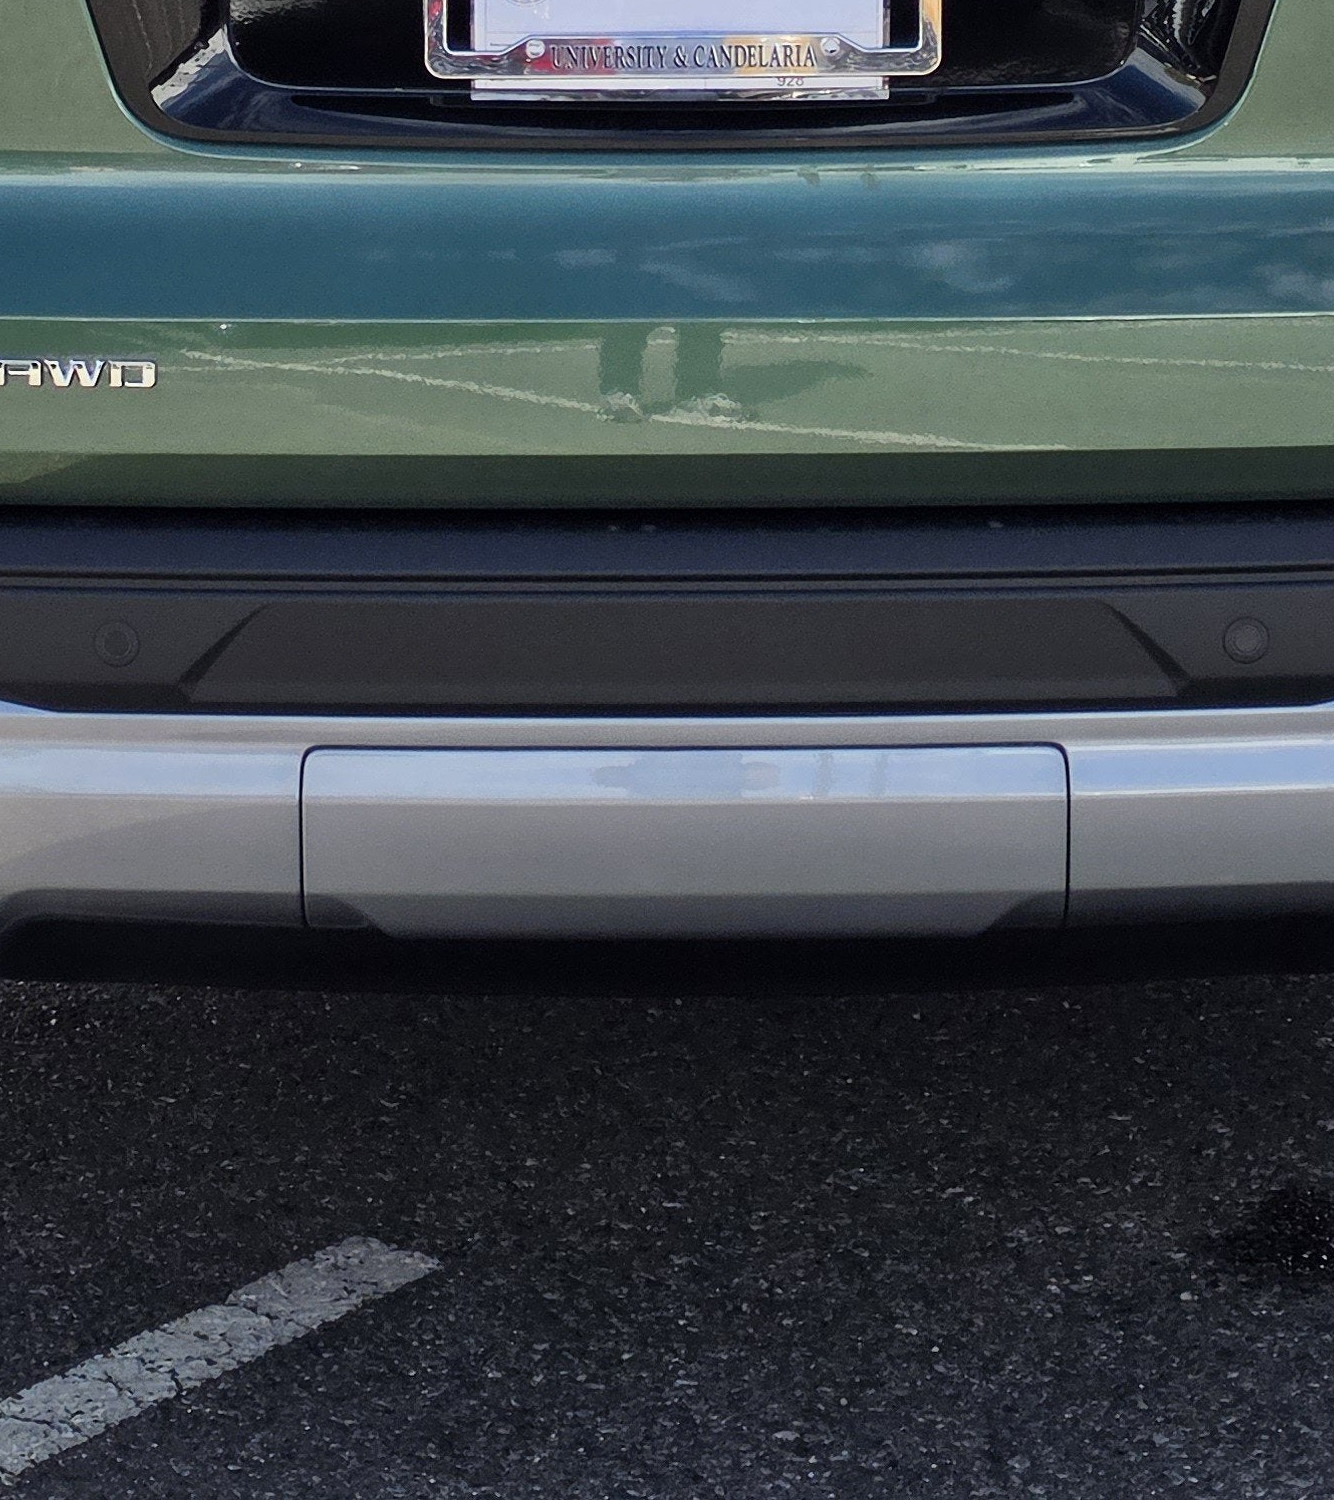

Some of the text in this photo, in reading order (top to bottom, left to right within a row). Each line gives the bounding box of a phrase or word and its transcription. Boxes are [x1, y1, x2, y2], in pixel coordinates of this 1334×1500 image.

[551, 44, 818, 69] UNIVERSITY & CANDELARIA
